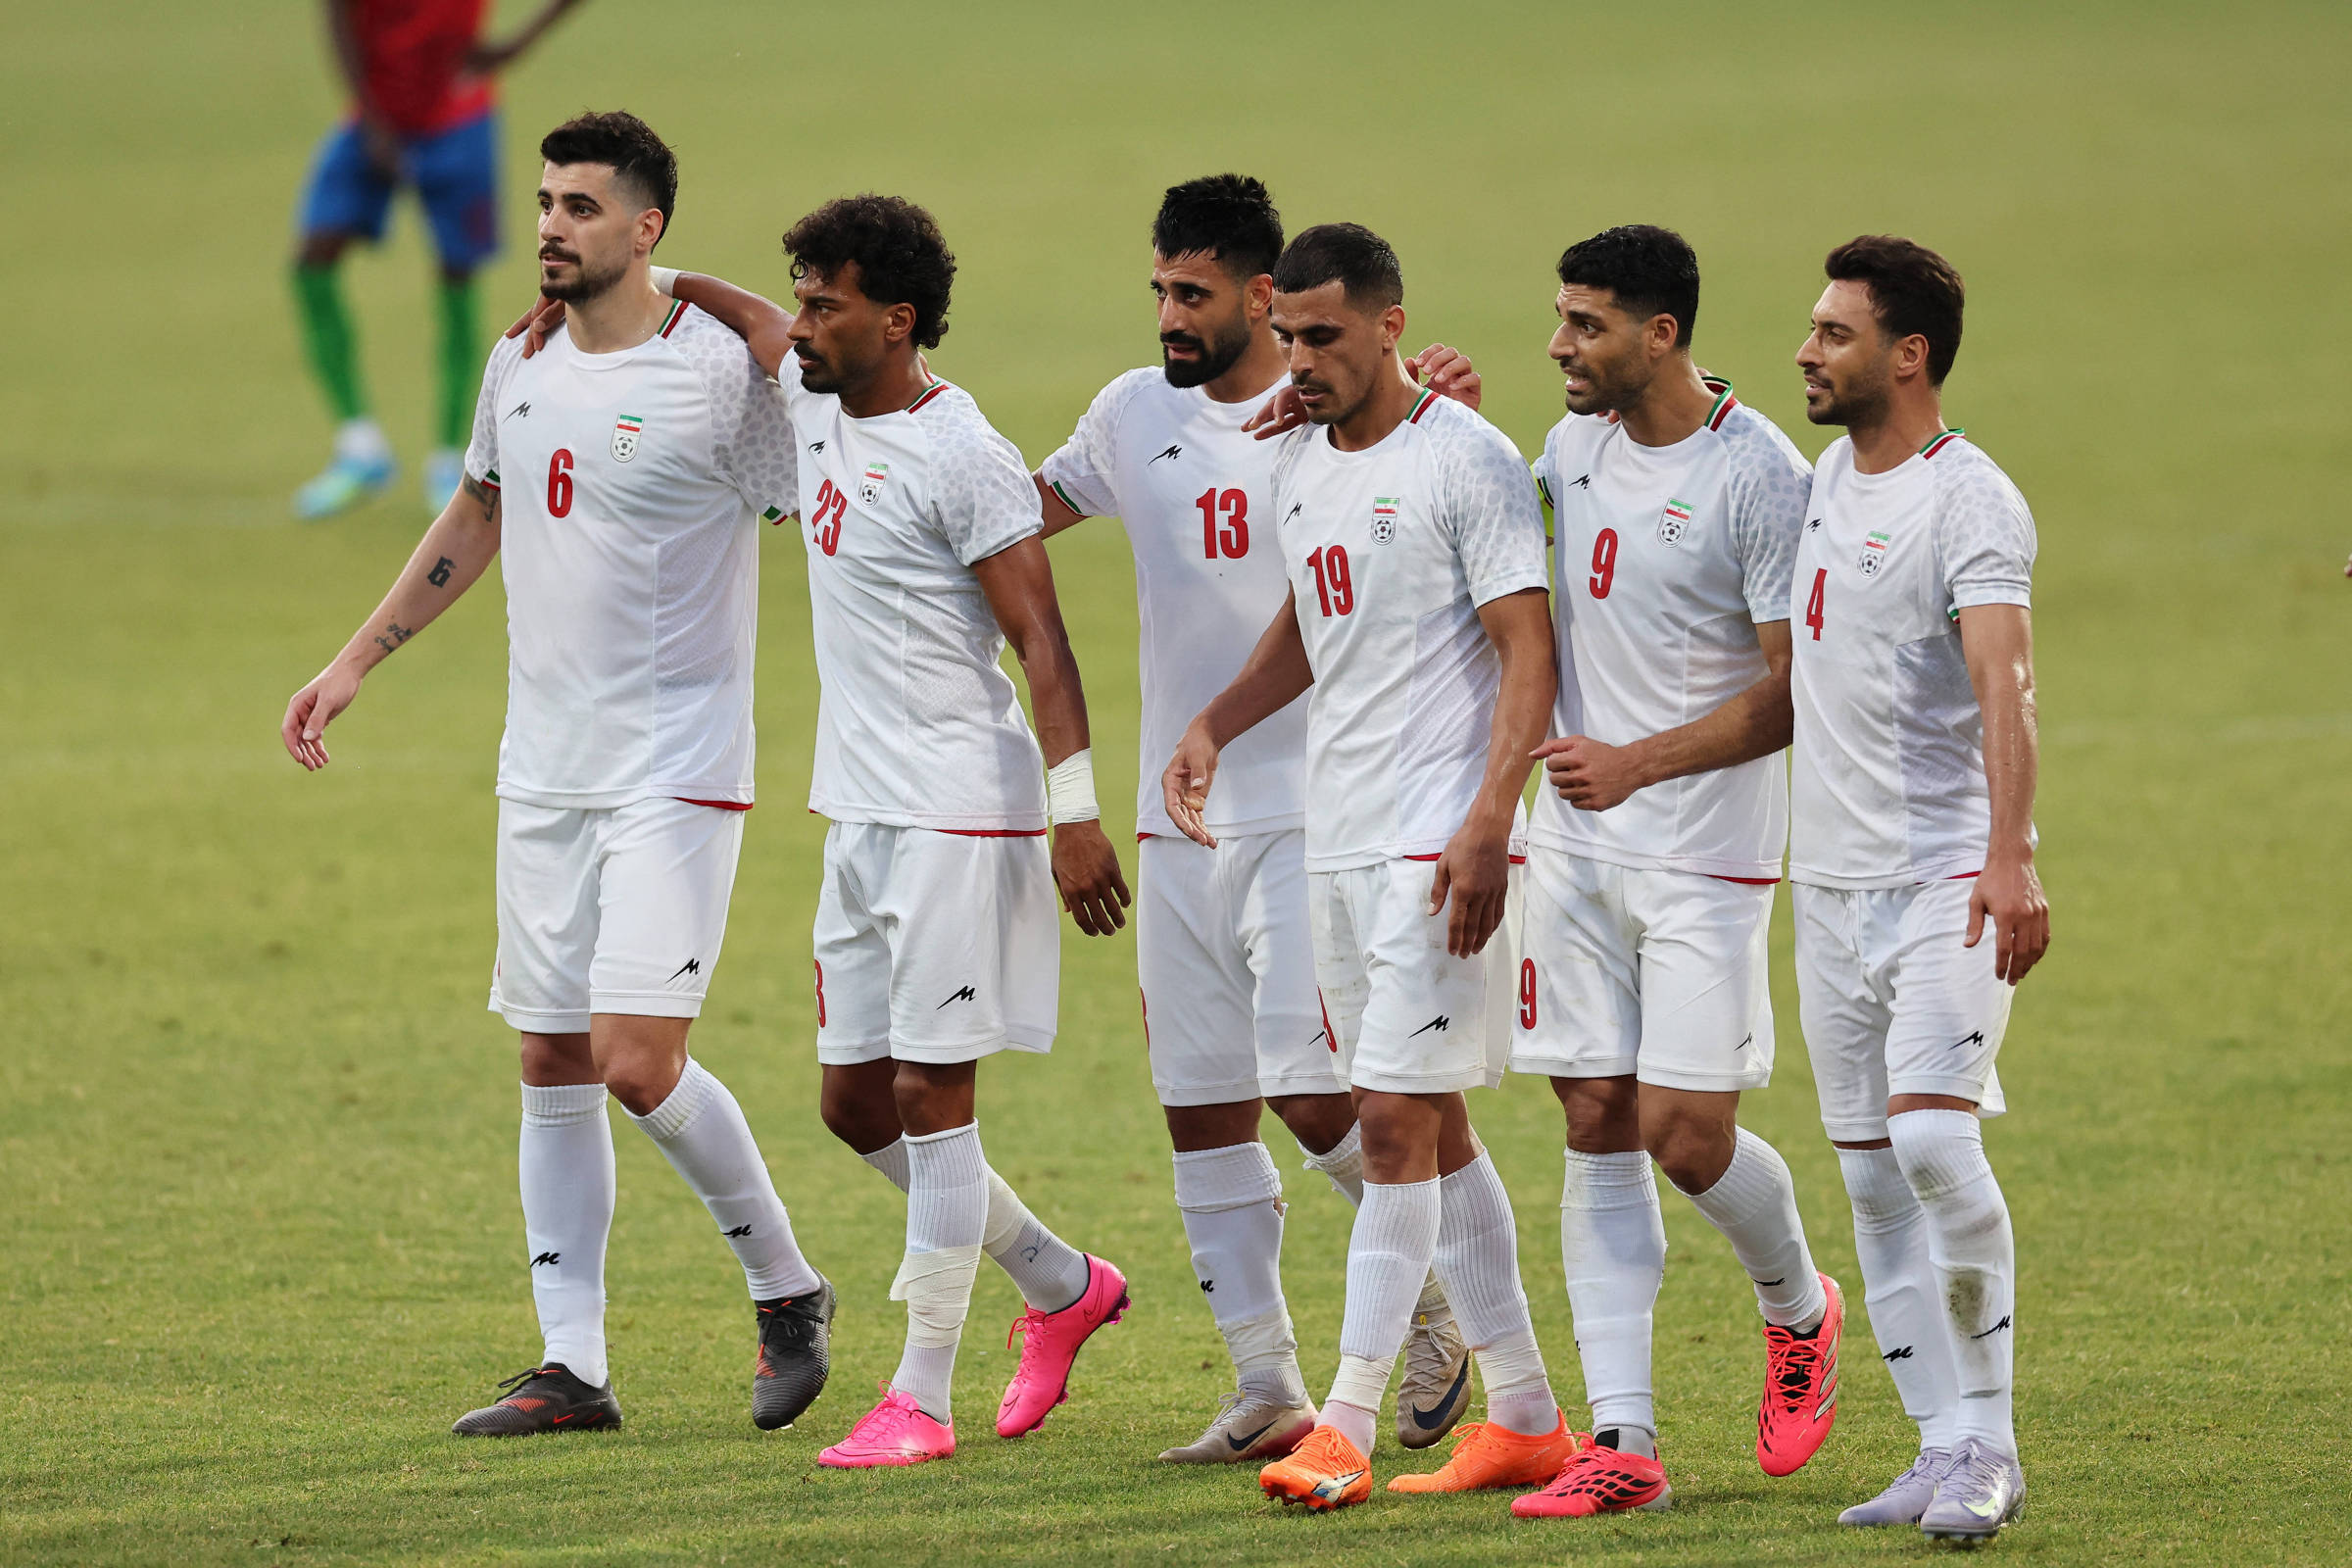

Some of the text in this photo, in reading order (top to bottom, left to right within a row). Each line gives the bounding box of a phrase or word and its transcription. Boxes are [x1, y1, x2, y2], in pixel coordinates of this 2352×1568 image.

[548, 448, 573, 518] 6
[811, 478, 848, 557] 23
[1196, 487, 1250, 560] 13
[1306, 545, 1354, 617] 19
[1590, 527, 1618, 600] 9
[1806, 568, 1828, 641] 4
[1520, 957, 1538, 1030] 9
